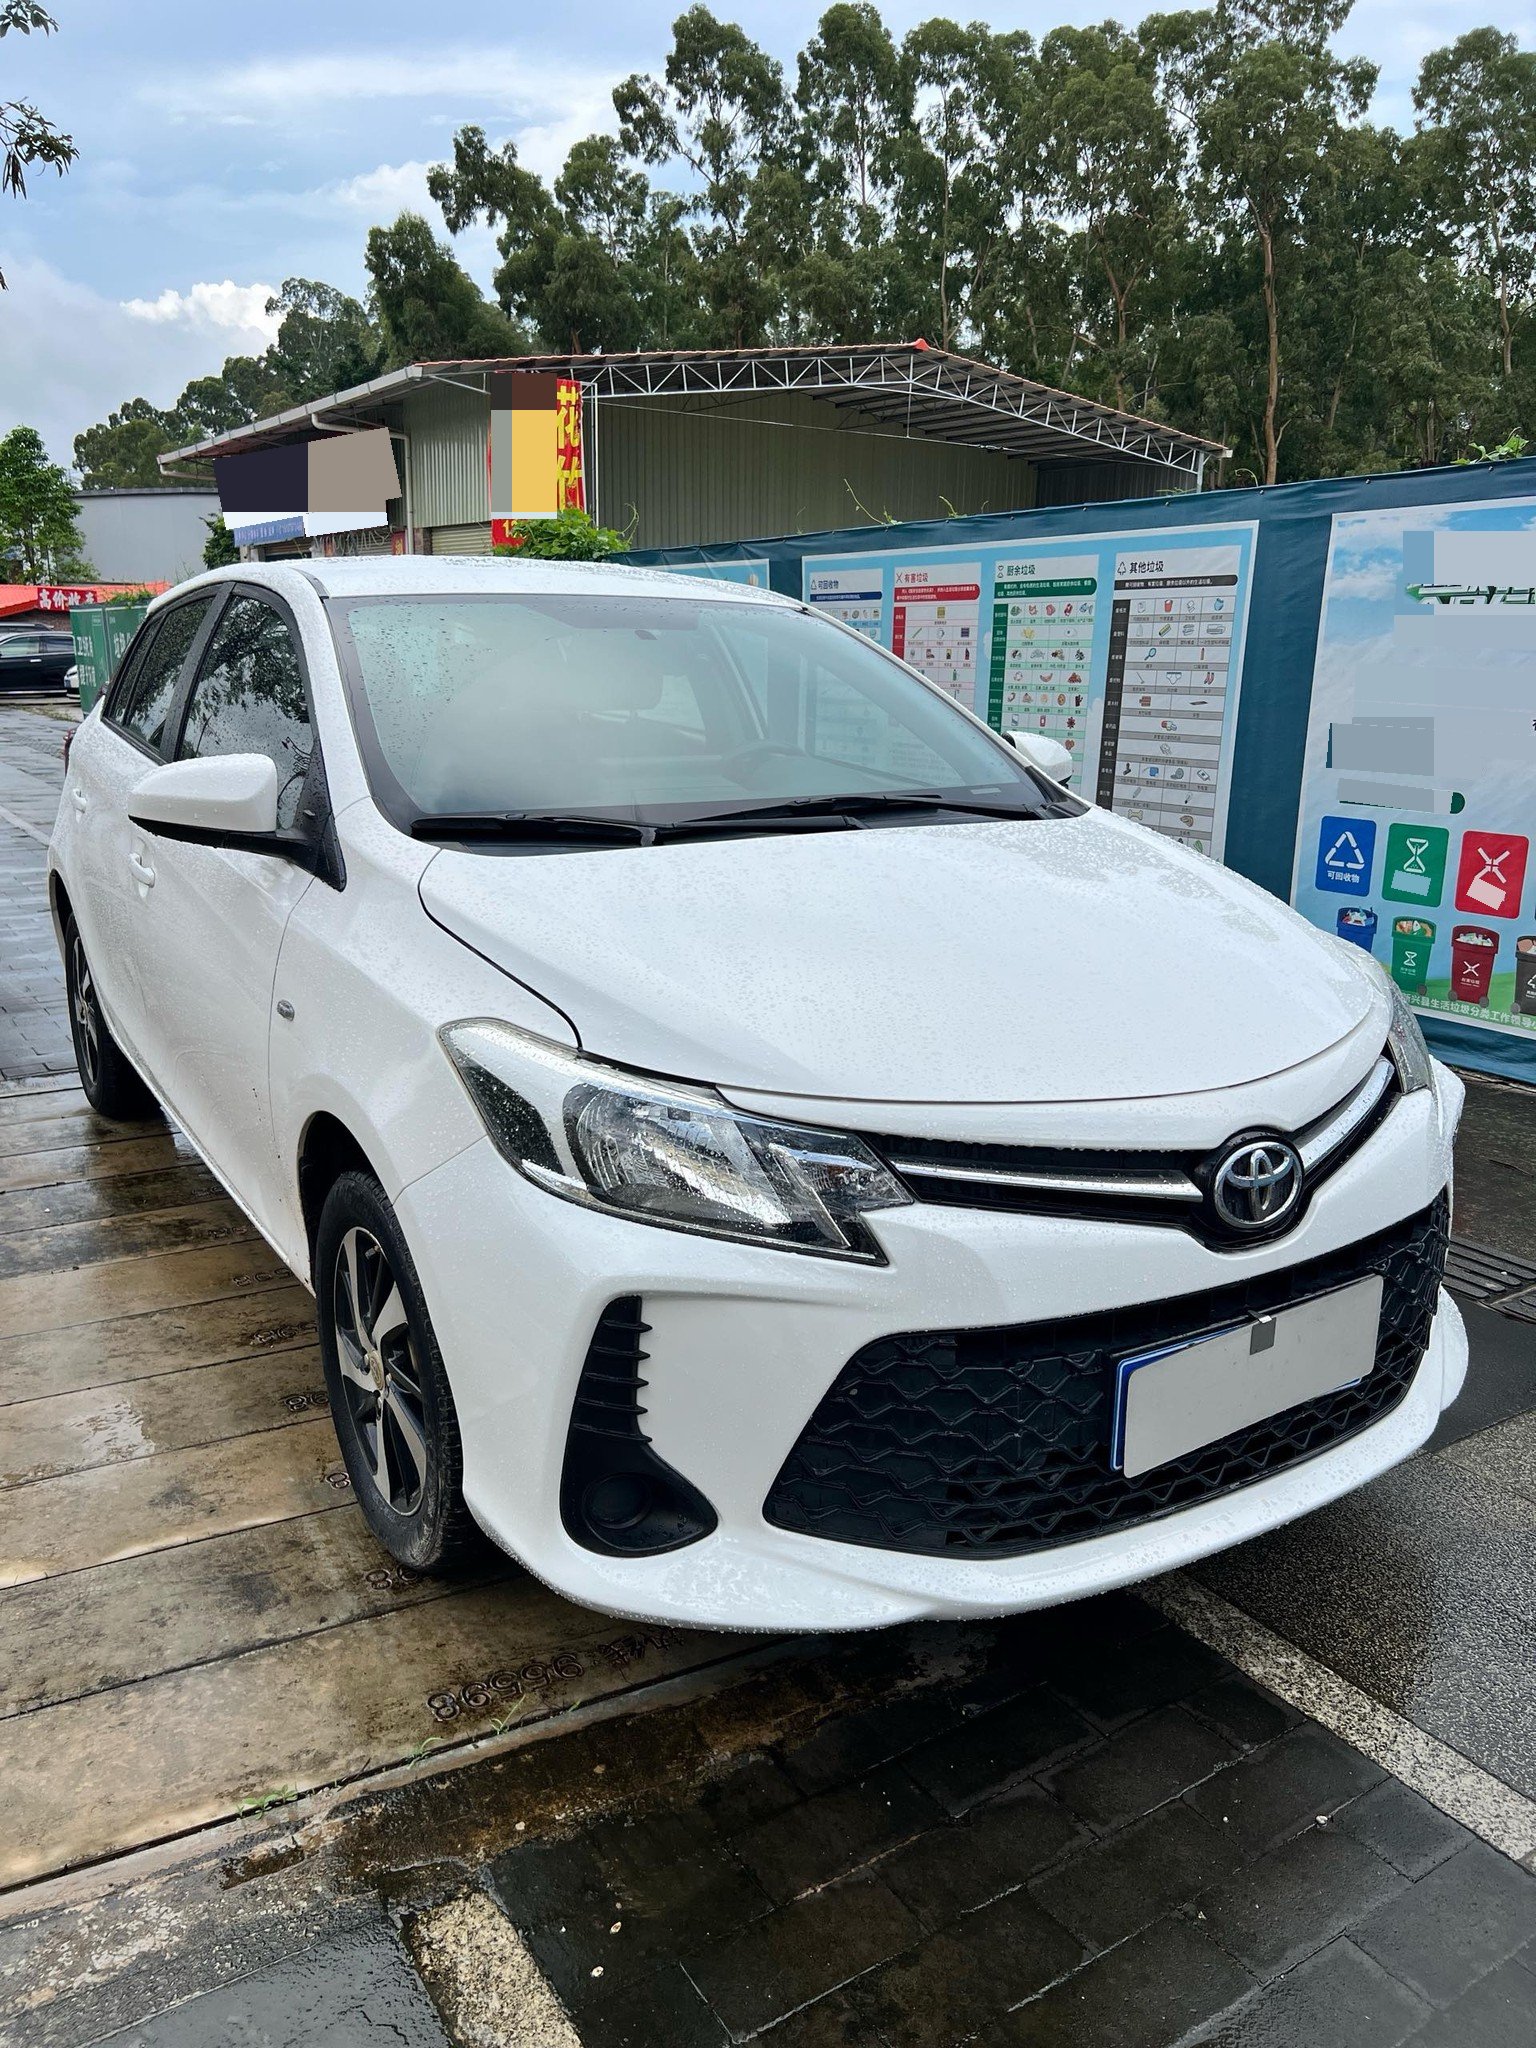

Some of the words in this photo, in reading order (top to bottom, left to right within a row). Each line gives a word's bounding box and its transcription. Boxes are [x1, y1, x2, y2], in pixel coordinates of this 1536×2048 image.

[1006, 564, 1036, 577] 厨余垃圾
[1129, 560, 1164, 574] 其他垃圾
[904, 572, 929, 583] 有害垃圾
[817, 580, 840, 590] 可回收物
[1326, 870, 1361, 884] 可回收物
